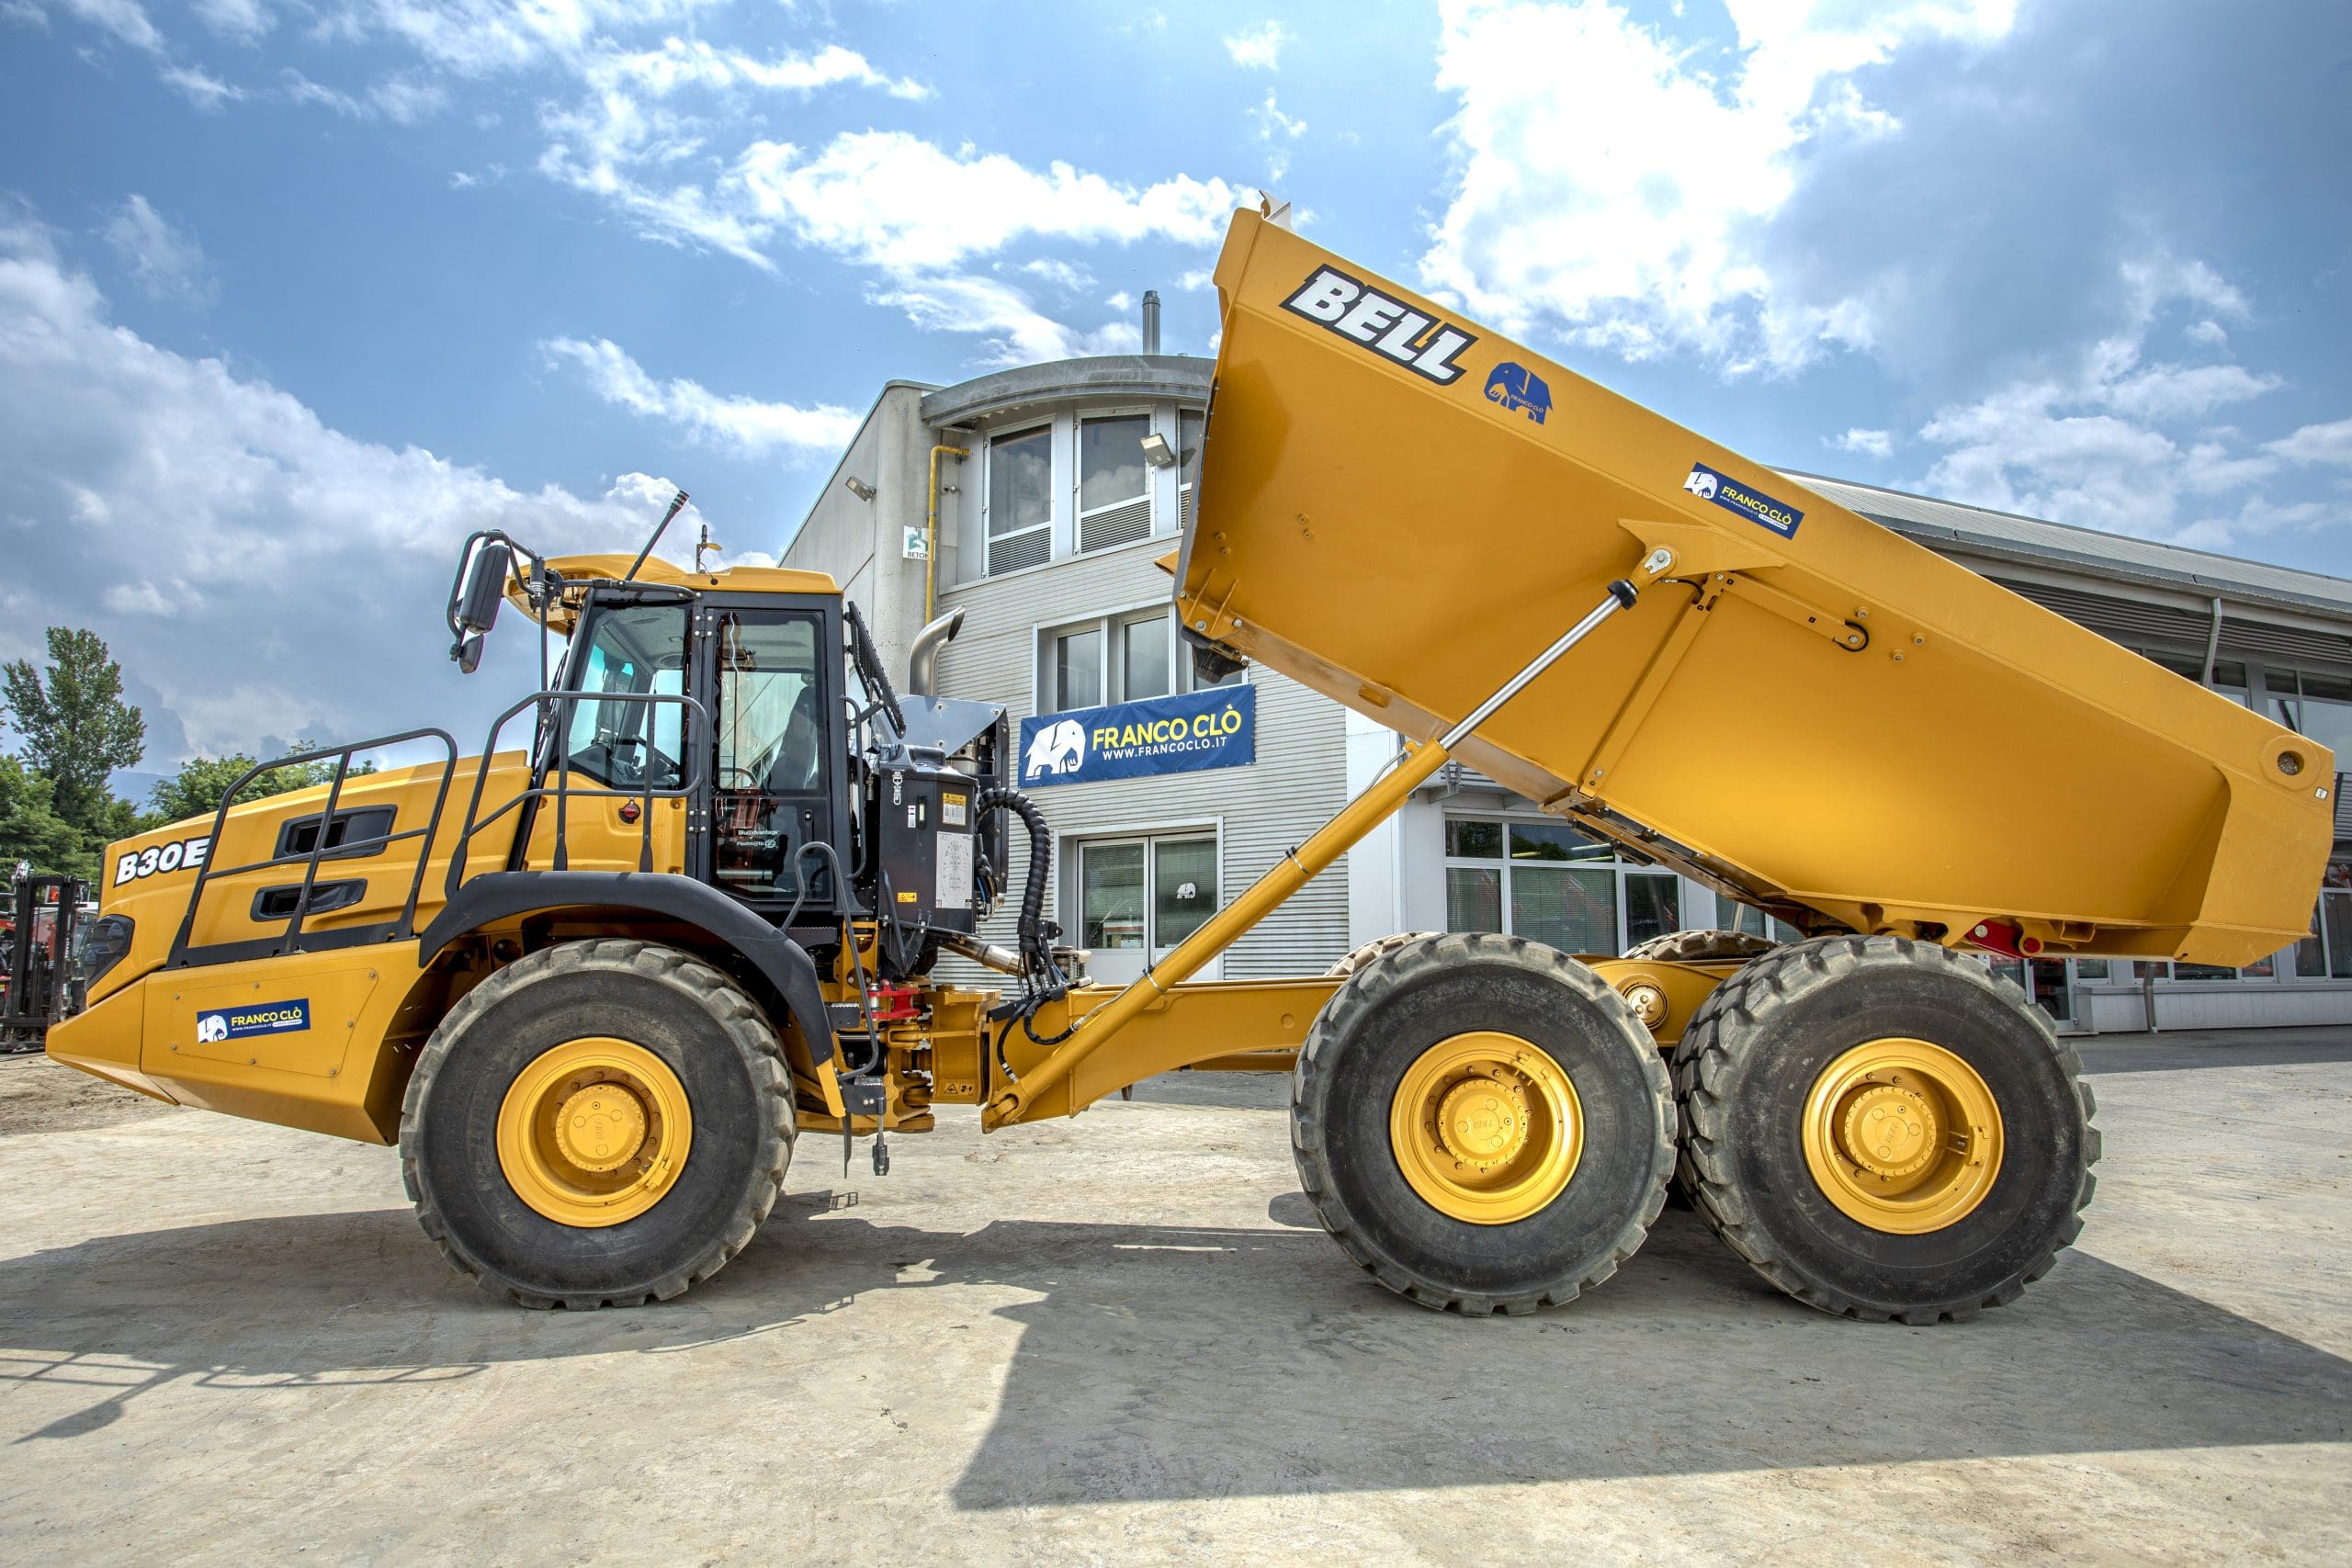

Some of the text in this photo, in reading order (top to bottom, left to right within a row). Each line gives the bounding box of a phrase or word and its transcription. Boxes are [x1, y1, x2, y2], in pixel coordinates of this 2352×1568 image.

[1283, 265, 1475, 383] BELL
[1510, 394, 1532, 408] FRANCO
[1721, 485, 1769, 513] FRANCO
[1769, 509, 1792, 525] CLÒ
[1092, 704, 1242, 751] FRANCO CLÒ
[1102, 736, 1227, 761] WWW.FRANCOCLO.IT
[114, 837, 210, 886] B30E
[231, 1011, 278, 1027] FRANCO
[279, 1006, 302, 1021] CLÒ
